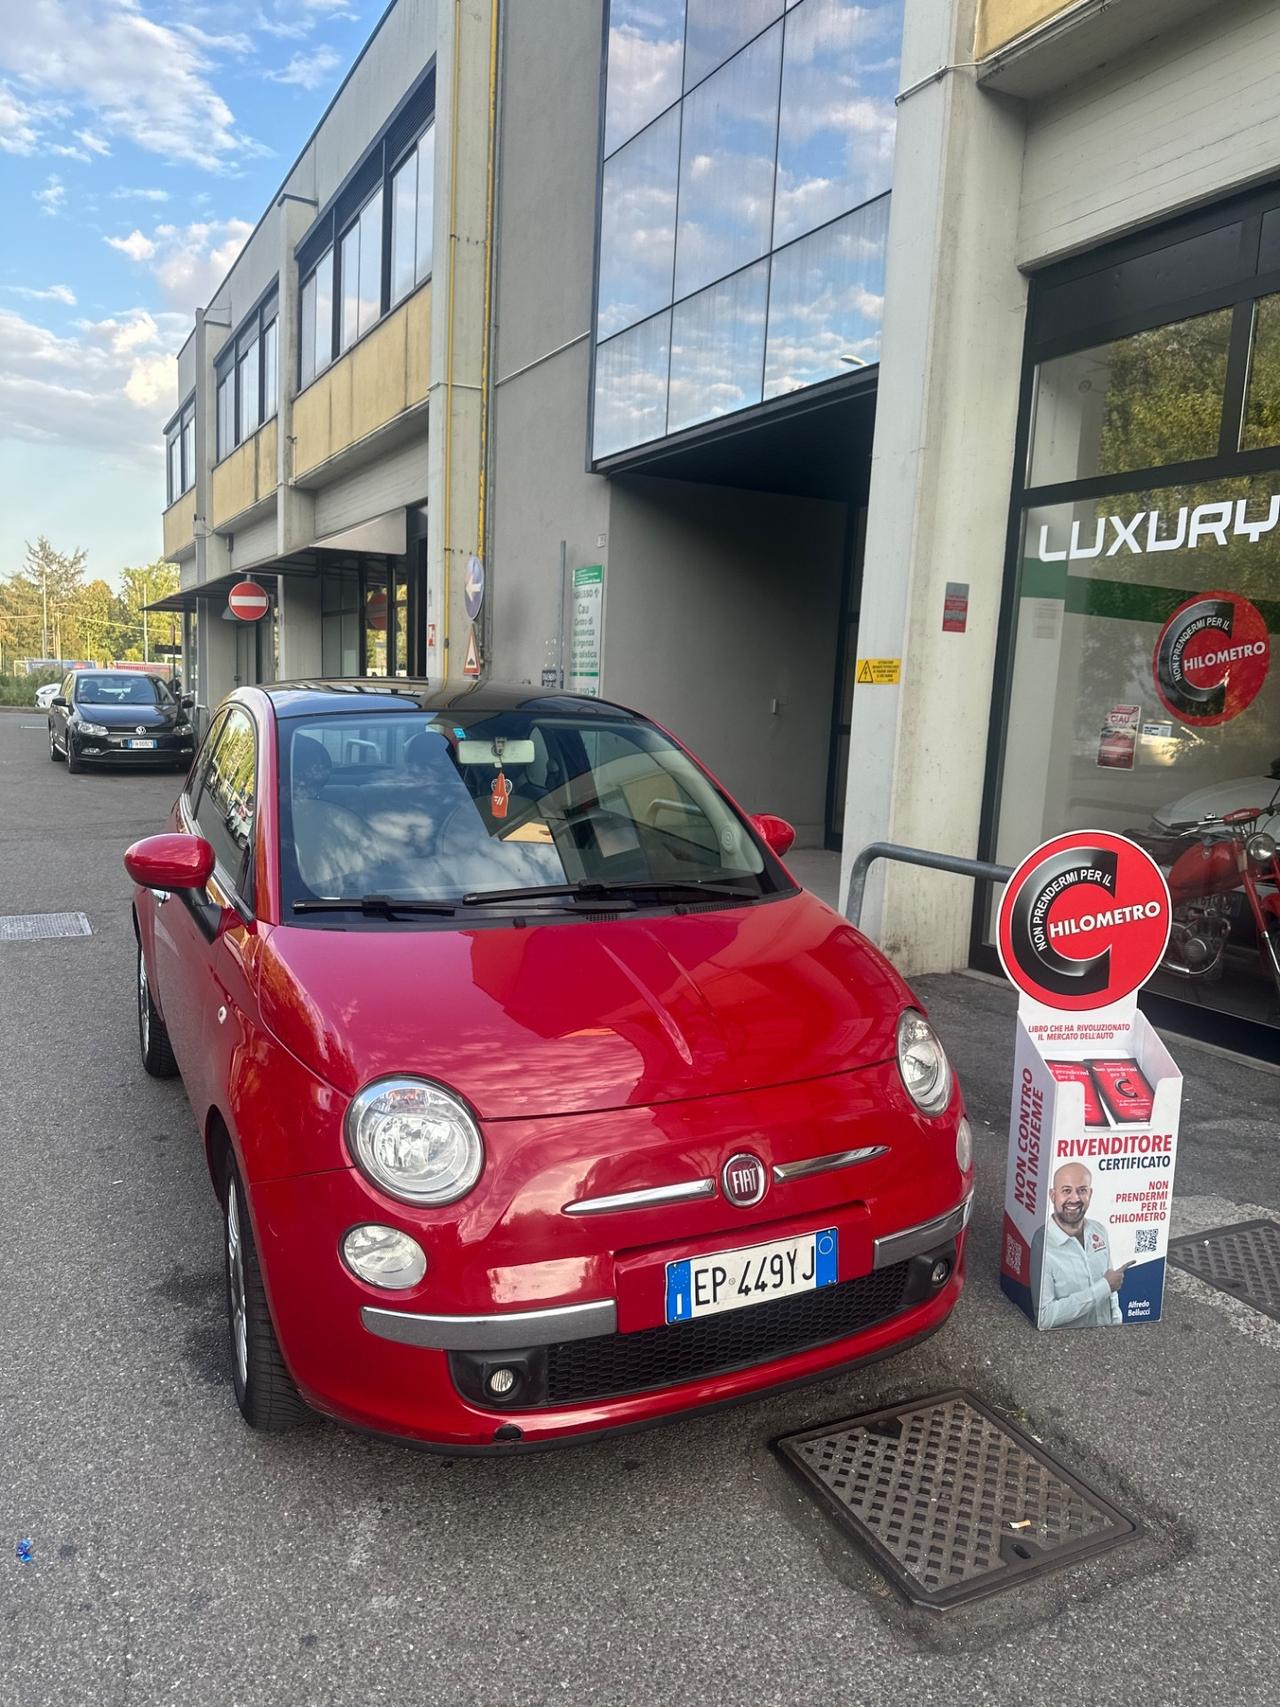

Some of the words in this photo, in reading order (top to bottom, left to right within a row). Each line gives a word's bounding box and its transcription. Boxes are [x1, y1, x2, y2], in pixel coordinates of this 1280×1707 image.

[1039, 495, 1280, 562] LUXURY
[1207, 617, 1223, 627] PER
[1223, 621, 1231, 631] IL
[1173, 619, 1206, 661] PRENDERMI
[1172, 661, 1182, 681] NON
[1080, 869, 1102, 882] PER
[1103, 874, 1113, 888] IL
[1033, 871, 1078, 924] PRENDERMI
[1033, 926, 1048, 952] NON
[1028, 1025, 1048, 1033] LIBRO
[1064, 1024, 1075, 1032] HA
[1076, 1023, 1131, 1032] RIVOLUZIONATO
[1047, 1033, 1079, 1041] MERCATO
[1018, 1067, 1033, 1153] CONTRO
[1027, 1087, 1044, 1176] INSIEME
[1056, 1134, 1173, 1158] RIVENDITORE
[1098, 1155, 1171, 1171] CERTIFICATO
[732, 1166, 757, 1195] FIAT
[1014, 1156, 1027, 1205] NON
[1148, 1180, 1169, 1191] NON
[1024, 1180, 1037, 1215] MA
[1115, 1191, 1168, 1203] PRENDERMI
[1141, 1202, 1158, 1212] PER
[1109, 1212, 1167, 1224] CHILOMETRO
[694, 1267, 727, 1307] EP
[737, 1245, 816, 1297] 449YJ
[1128, 1300, 1150, 1309] Alfredo
[1128, 1308, 1151, 1317] Bellucci
